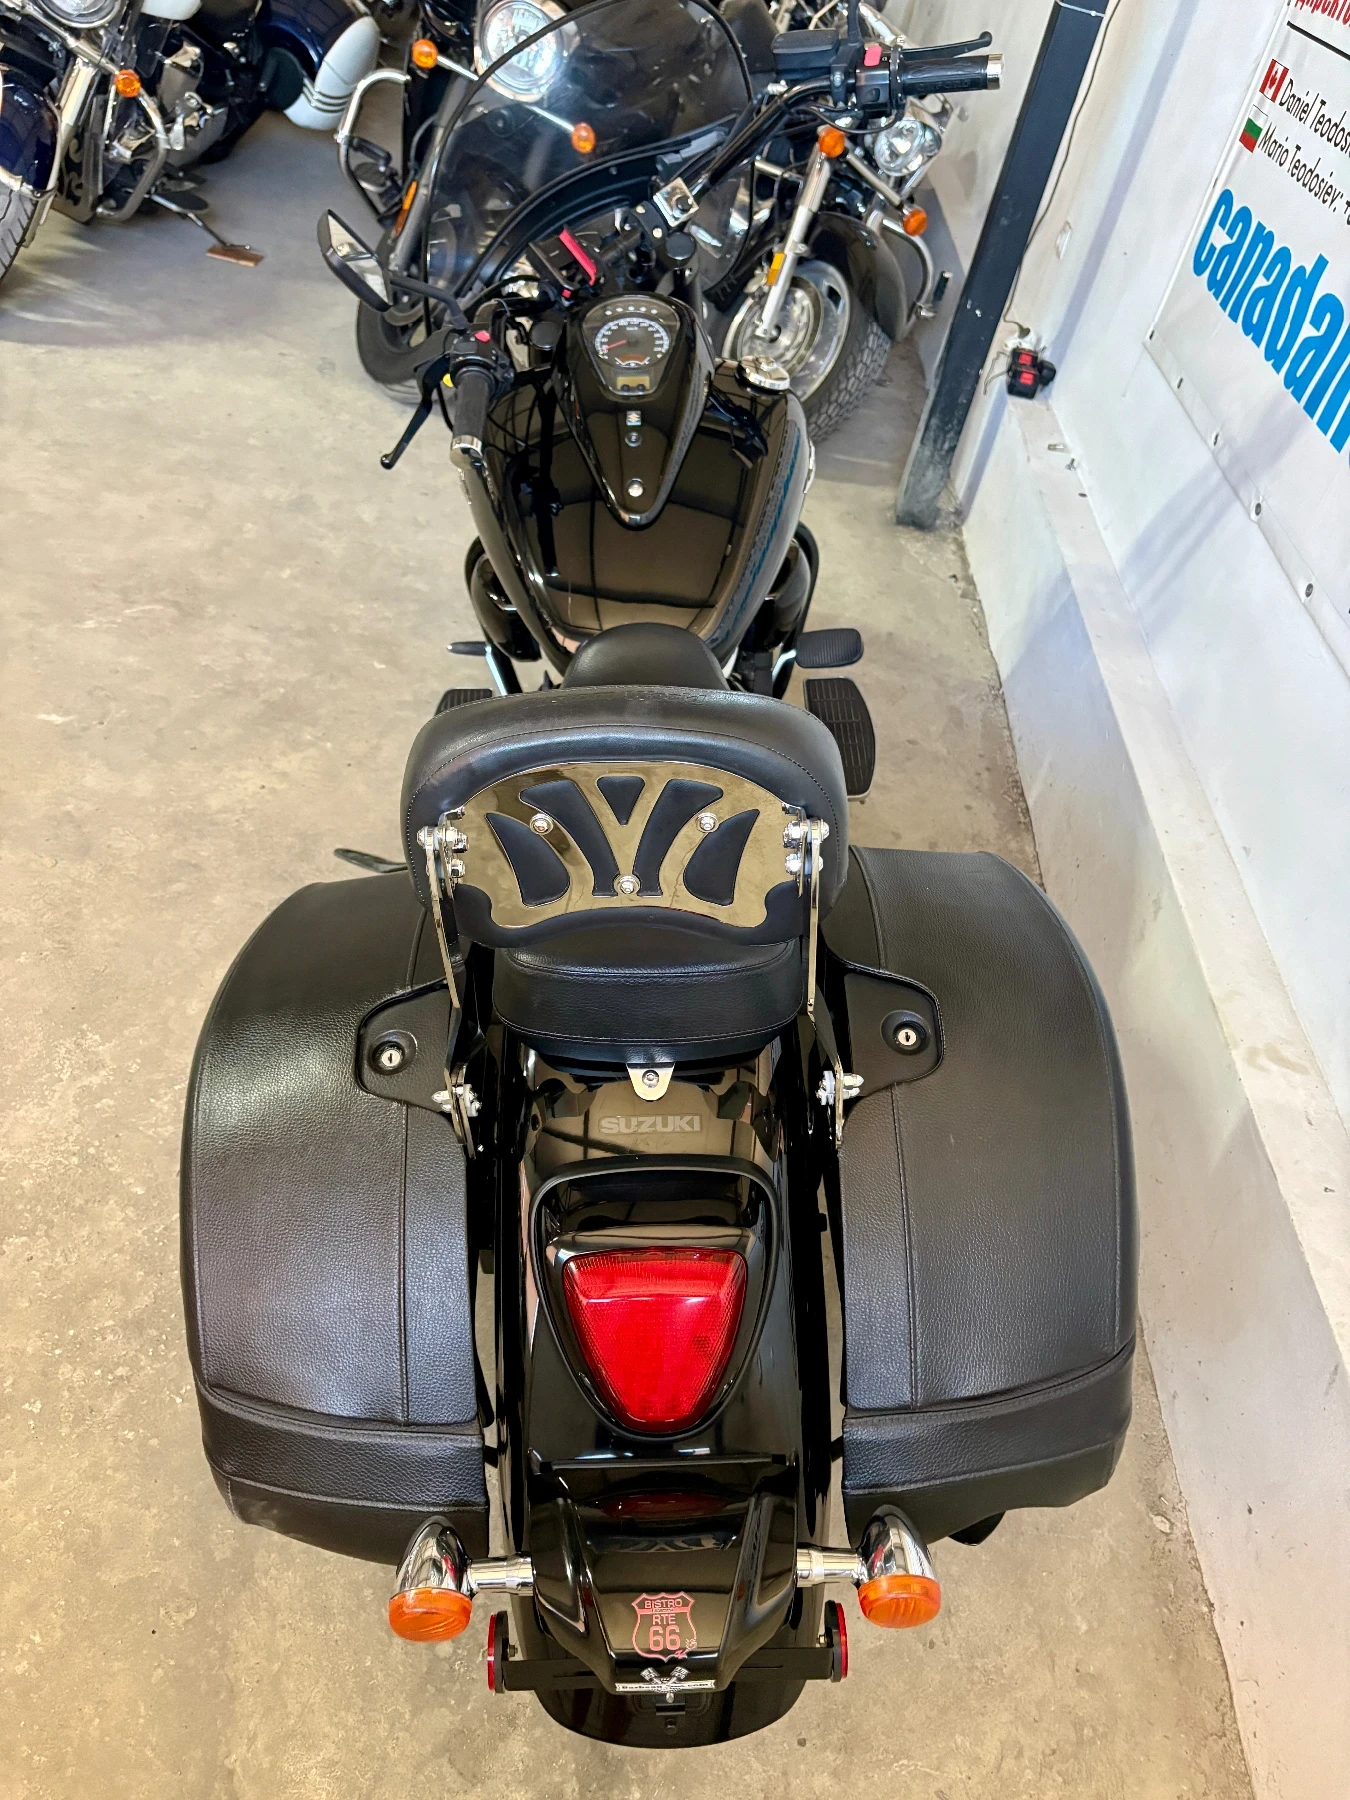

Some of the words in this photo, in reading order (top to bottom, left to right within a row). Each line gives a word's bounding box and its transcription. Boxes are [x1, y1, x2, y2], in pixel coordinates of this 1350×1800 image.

[1278, 78, 1319, 124] Daniel
[1309, 99, 1350, 158] Teodos
[1258, 122, 1289, 167] Mario
[1287, 144, 1344, 213] Teodosiev:
[600, 1115, 701, 1134] SUZUKI
[645, 1599, 683, 1609] BISTRO
[652, 1613, 676, 1625] RTE
[649, 1624, 681, 1651] 66
